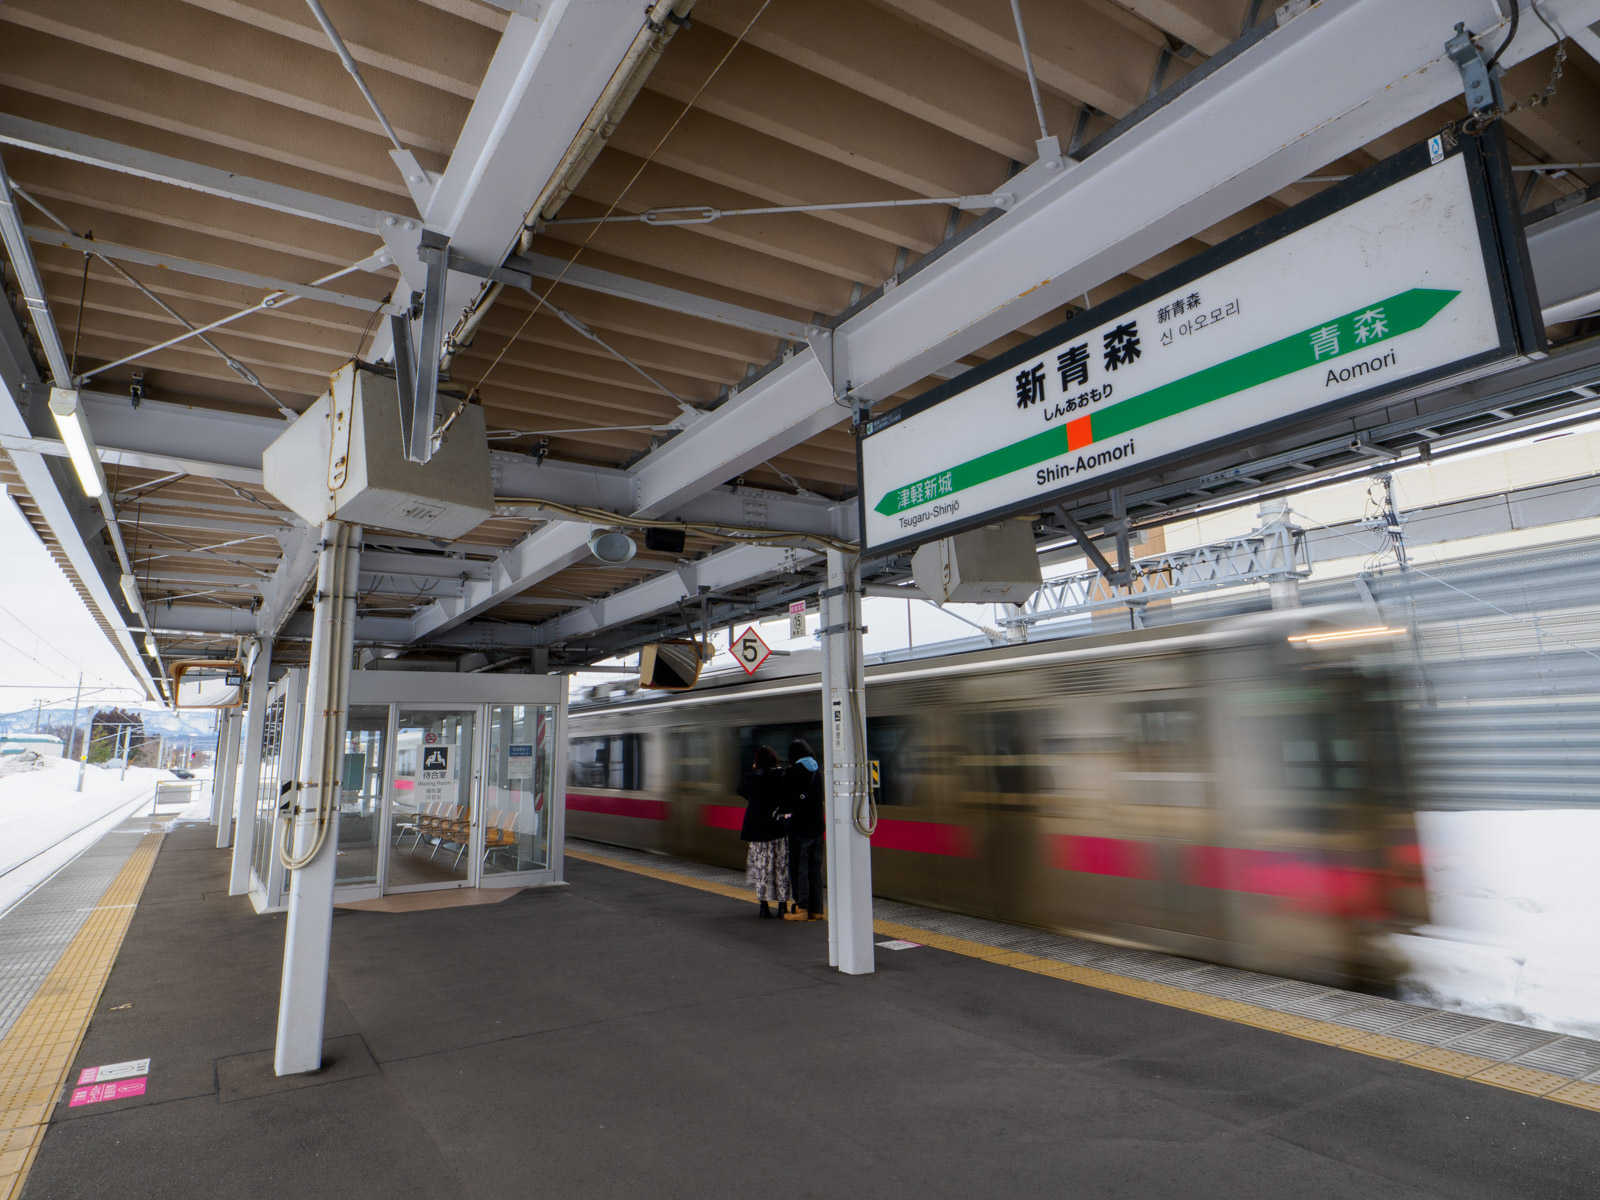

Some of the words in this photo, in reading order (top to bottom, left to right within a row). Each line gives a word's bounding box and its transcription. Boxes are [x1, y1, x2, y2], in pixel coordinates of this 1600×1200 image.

[1157, 293, 1202, 323] 新青森
[1160, 330, 1174, 346] 신
[1179, 299, 1241, 336] 아오모리
[1309, 307, 1390, 361] 青森
[1015, 320, 1142, 410] 新青森
[1325, 348, 1396, 387] Aomori
[1043, 383, 1114, 422] しんあおもり
[1036, 438, 1136, 486] Shin-Aomori
[897, 472, 953, 510] 津軽新城
[899, 500, 960, 529] Tsugaru-Shinjō
[743, 639, 757, 662] 5
[423, 771, 447, 780] 待合室
